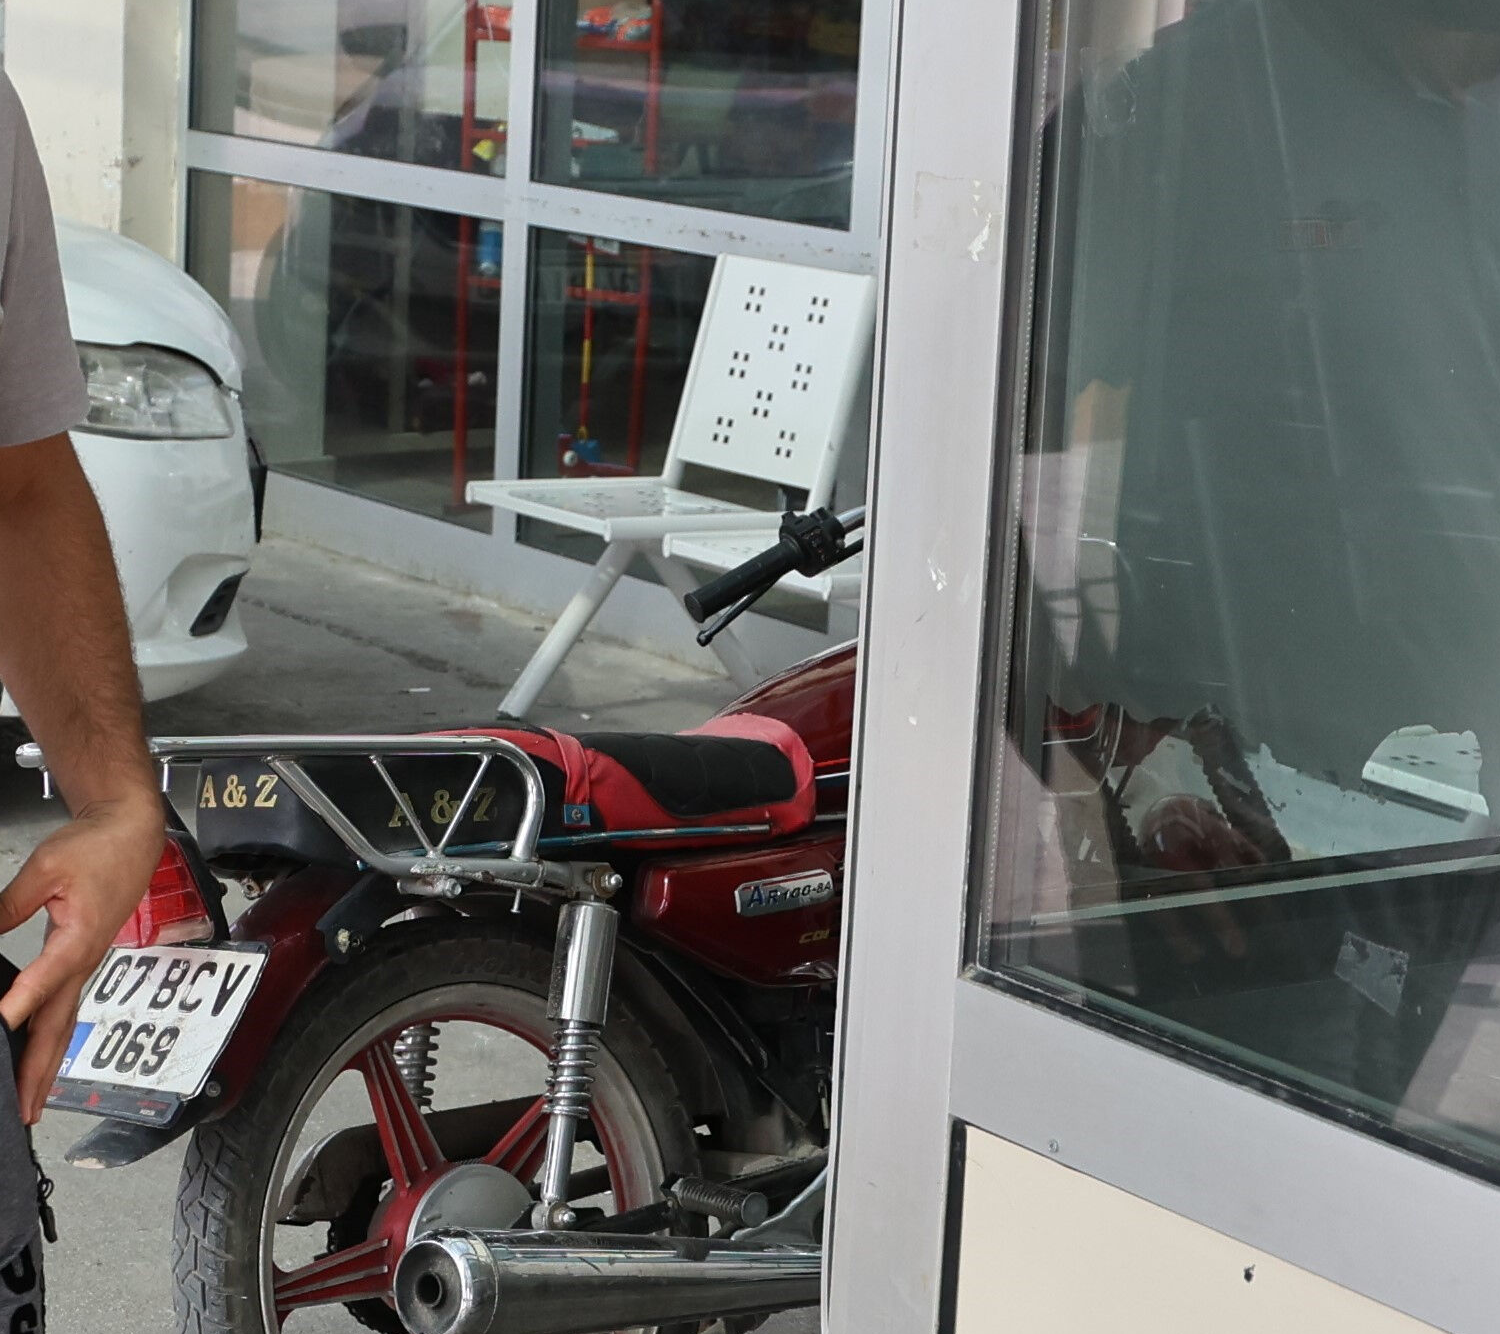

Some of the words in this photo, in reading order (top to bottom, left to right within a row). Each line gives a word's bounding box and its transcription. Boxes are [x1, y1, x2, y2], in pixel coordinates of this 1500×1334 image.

[200, 775, 216, 808] A
[223, 774, 246, 808] &
[254, 774, 279, 807] Z
[94, 955, 160, 1005] 07
[147, 958, 251, 1017] BCV
[91, 1020, 180, 1077] 069
